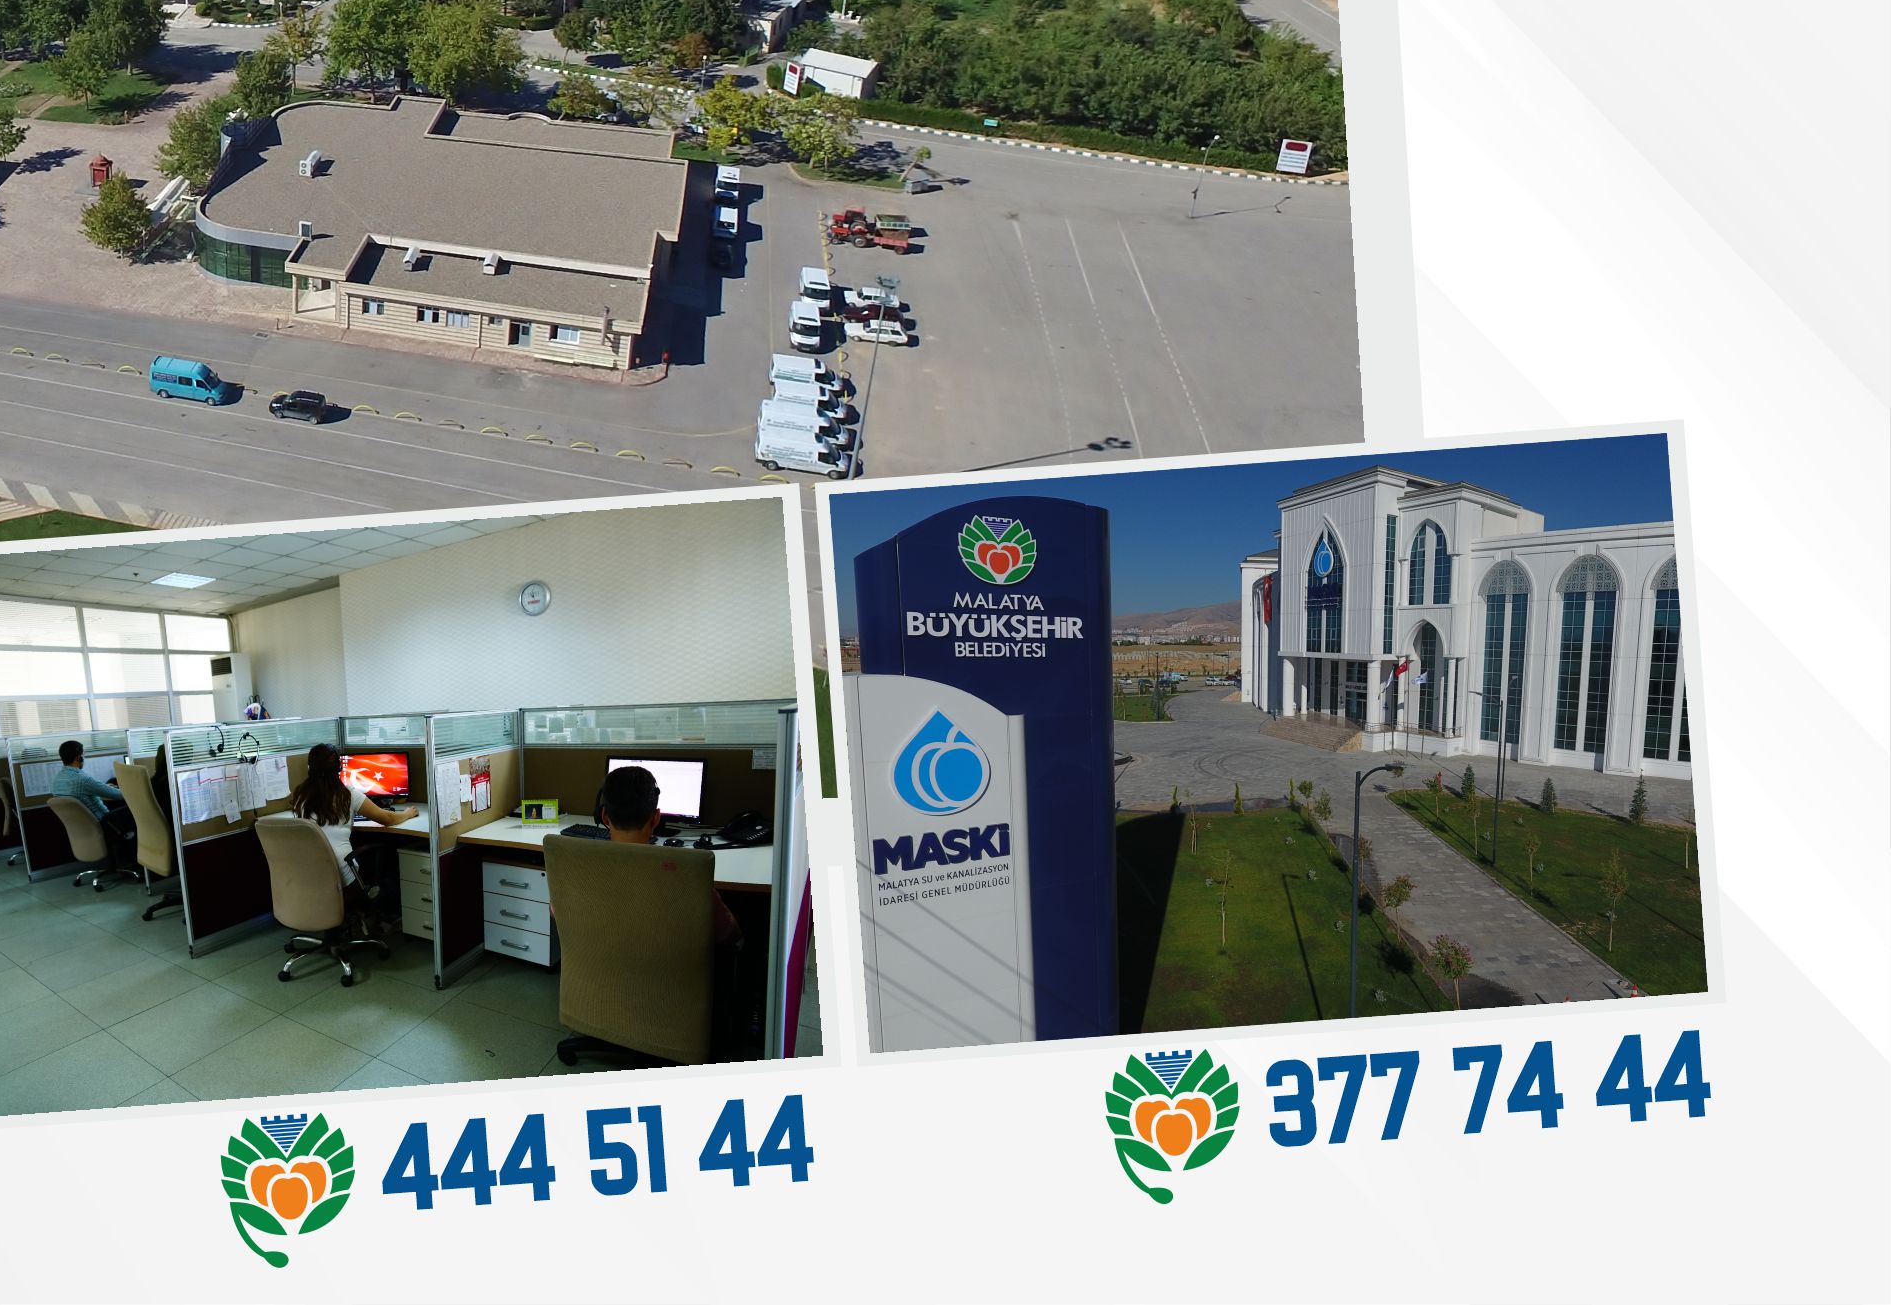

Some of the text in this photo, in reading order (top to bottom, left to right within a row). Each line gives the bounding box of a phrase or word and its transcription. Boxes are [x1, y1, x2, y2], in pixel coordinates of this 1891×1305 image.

[953, 591, 1045, 611] MALATYA
[878, 863, 1009, 891] MALATYA SU ve KANALİZASYON
[921, 887, 952, 899] GENEL
[954, 875, 1010, 894] MÜDÜRLÜĞÜ
